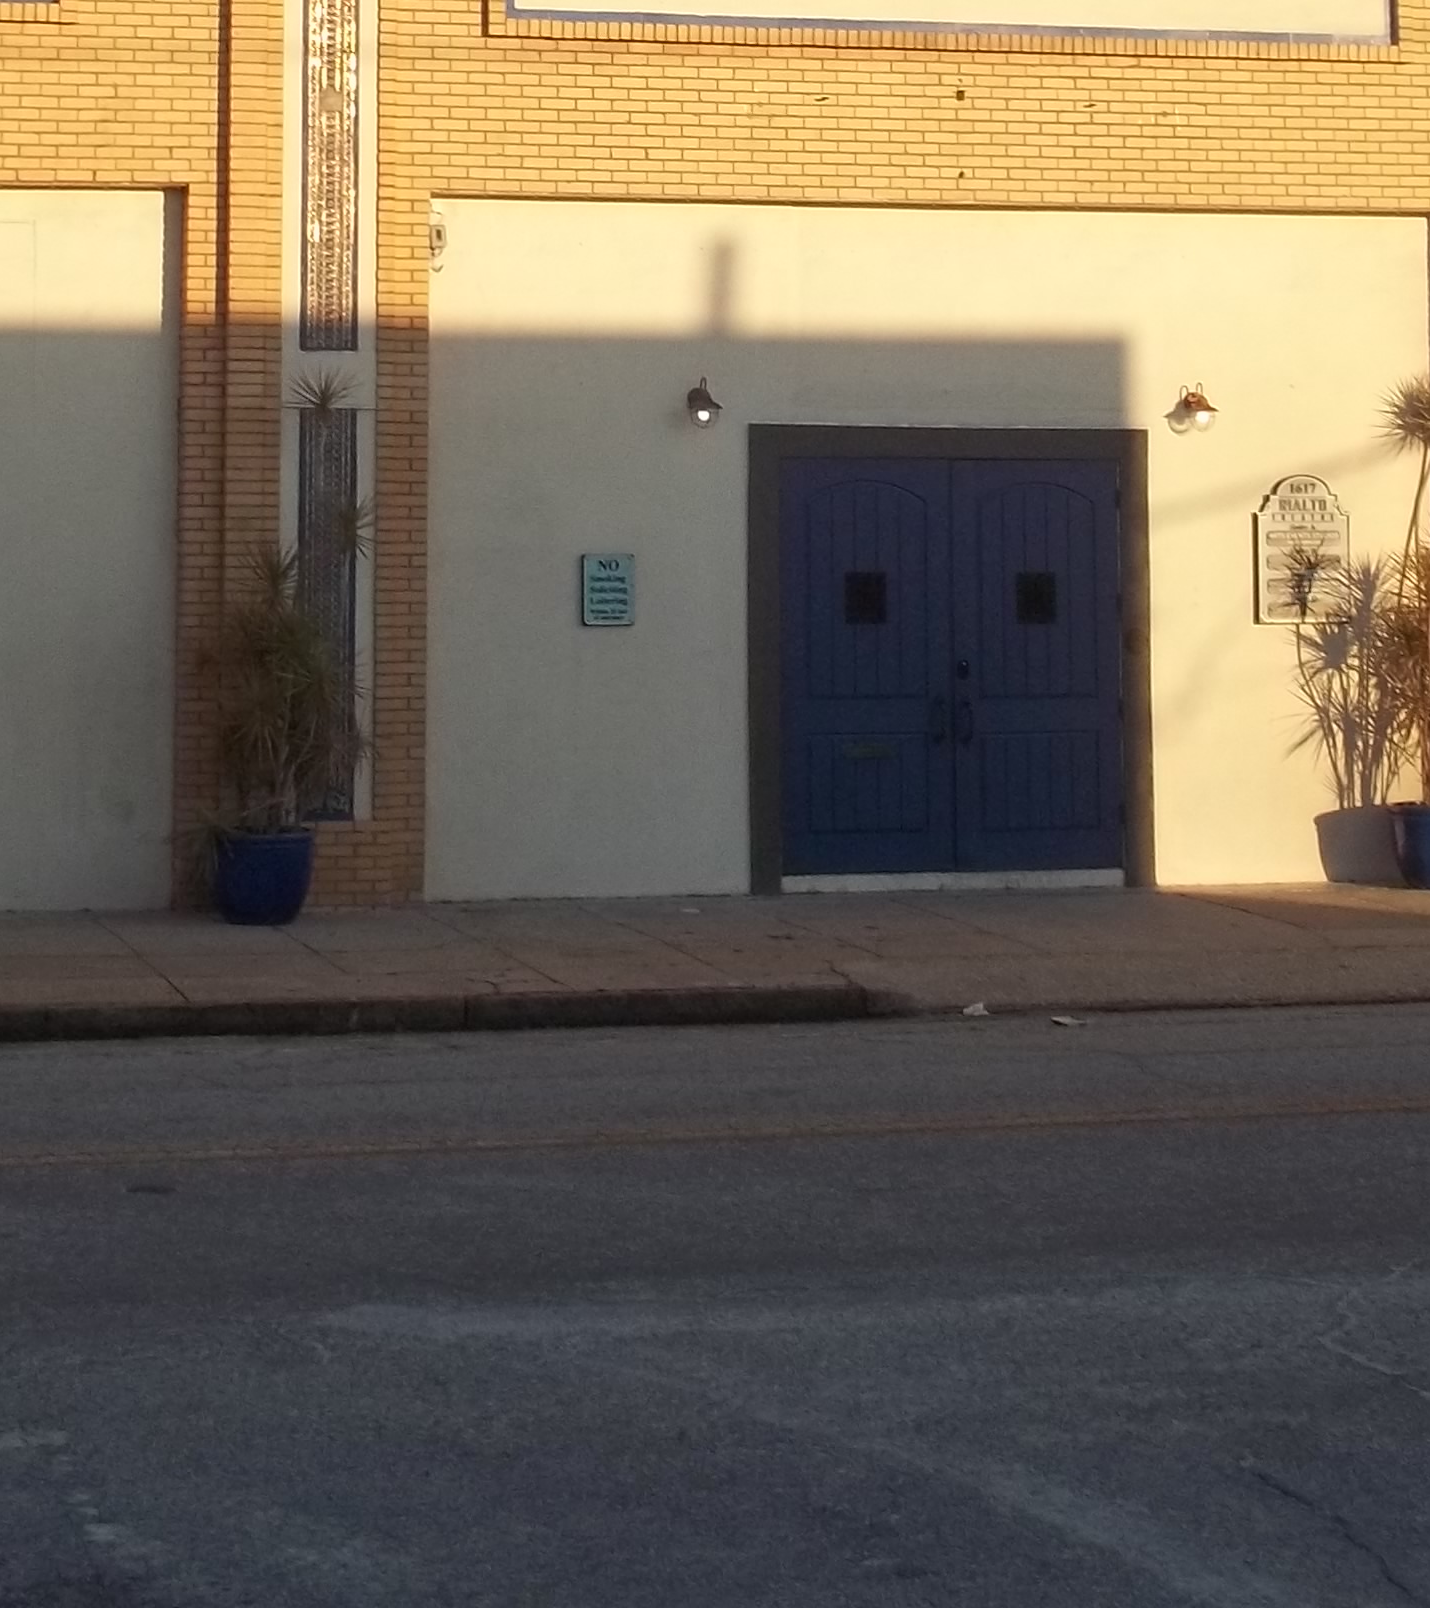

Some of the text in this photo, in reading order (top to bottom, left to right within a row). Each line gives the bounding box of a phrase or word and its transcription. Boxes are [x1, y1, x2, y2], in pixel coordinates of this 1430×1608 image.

[1289, 483, 1316, 494] 1617
[1278, 498, 1327, 511] RIALTO
[597, 559, 620, 572] NO
